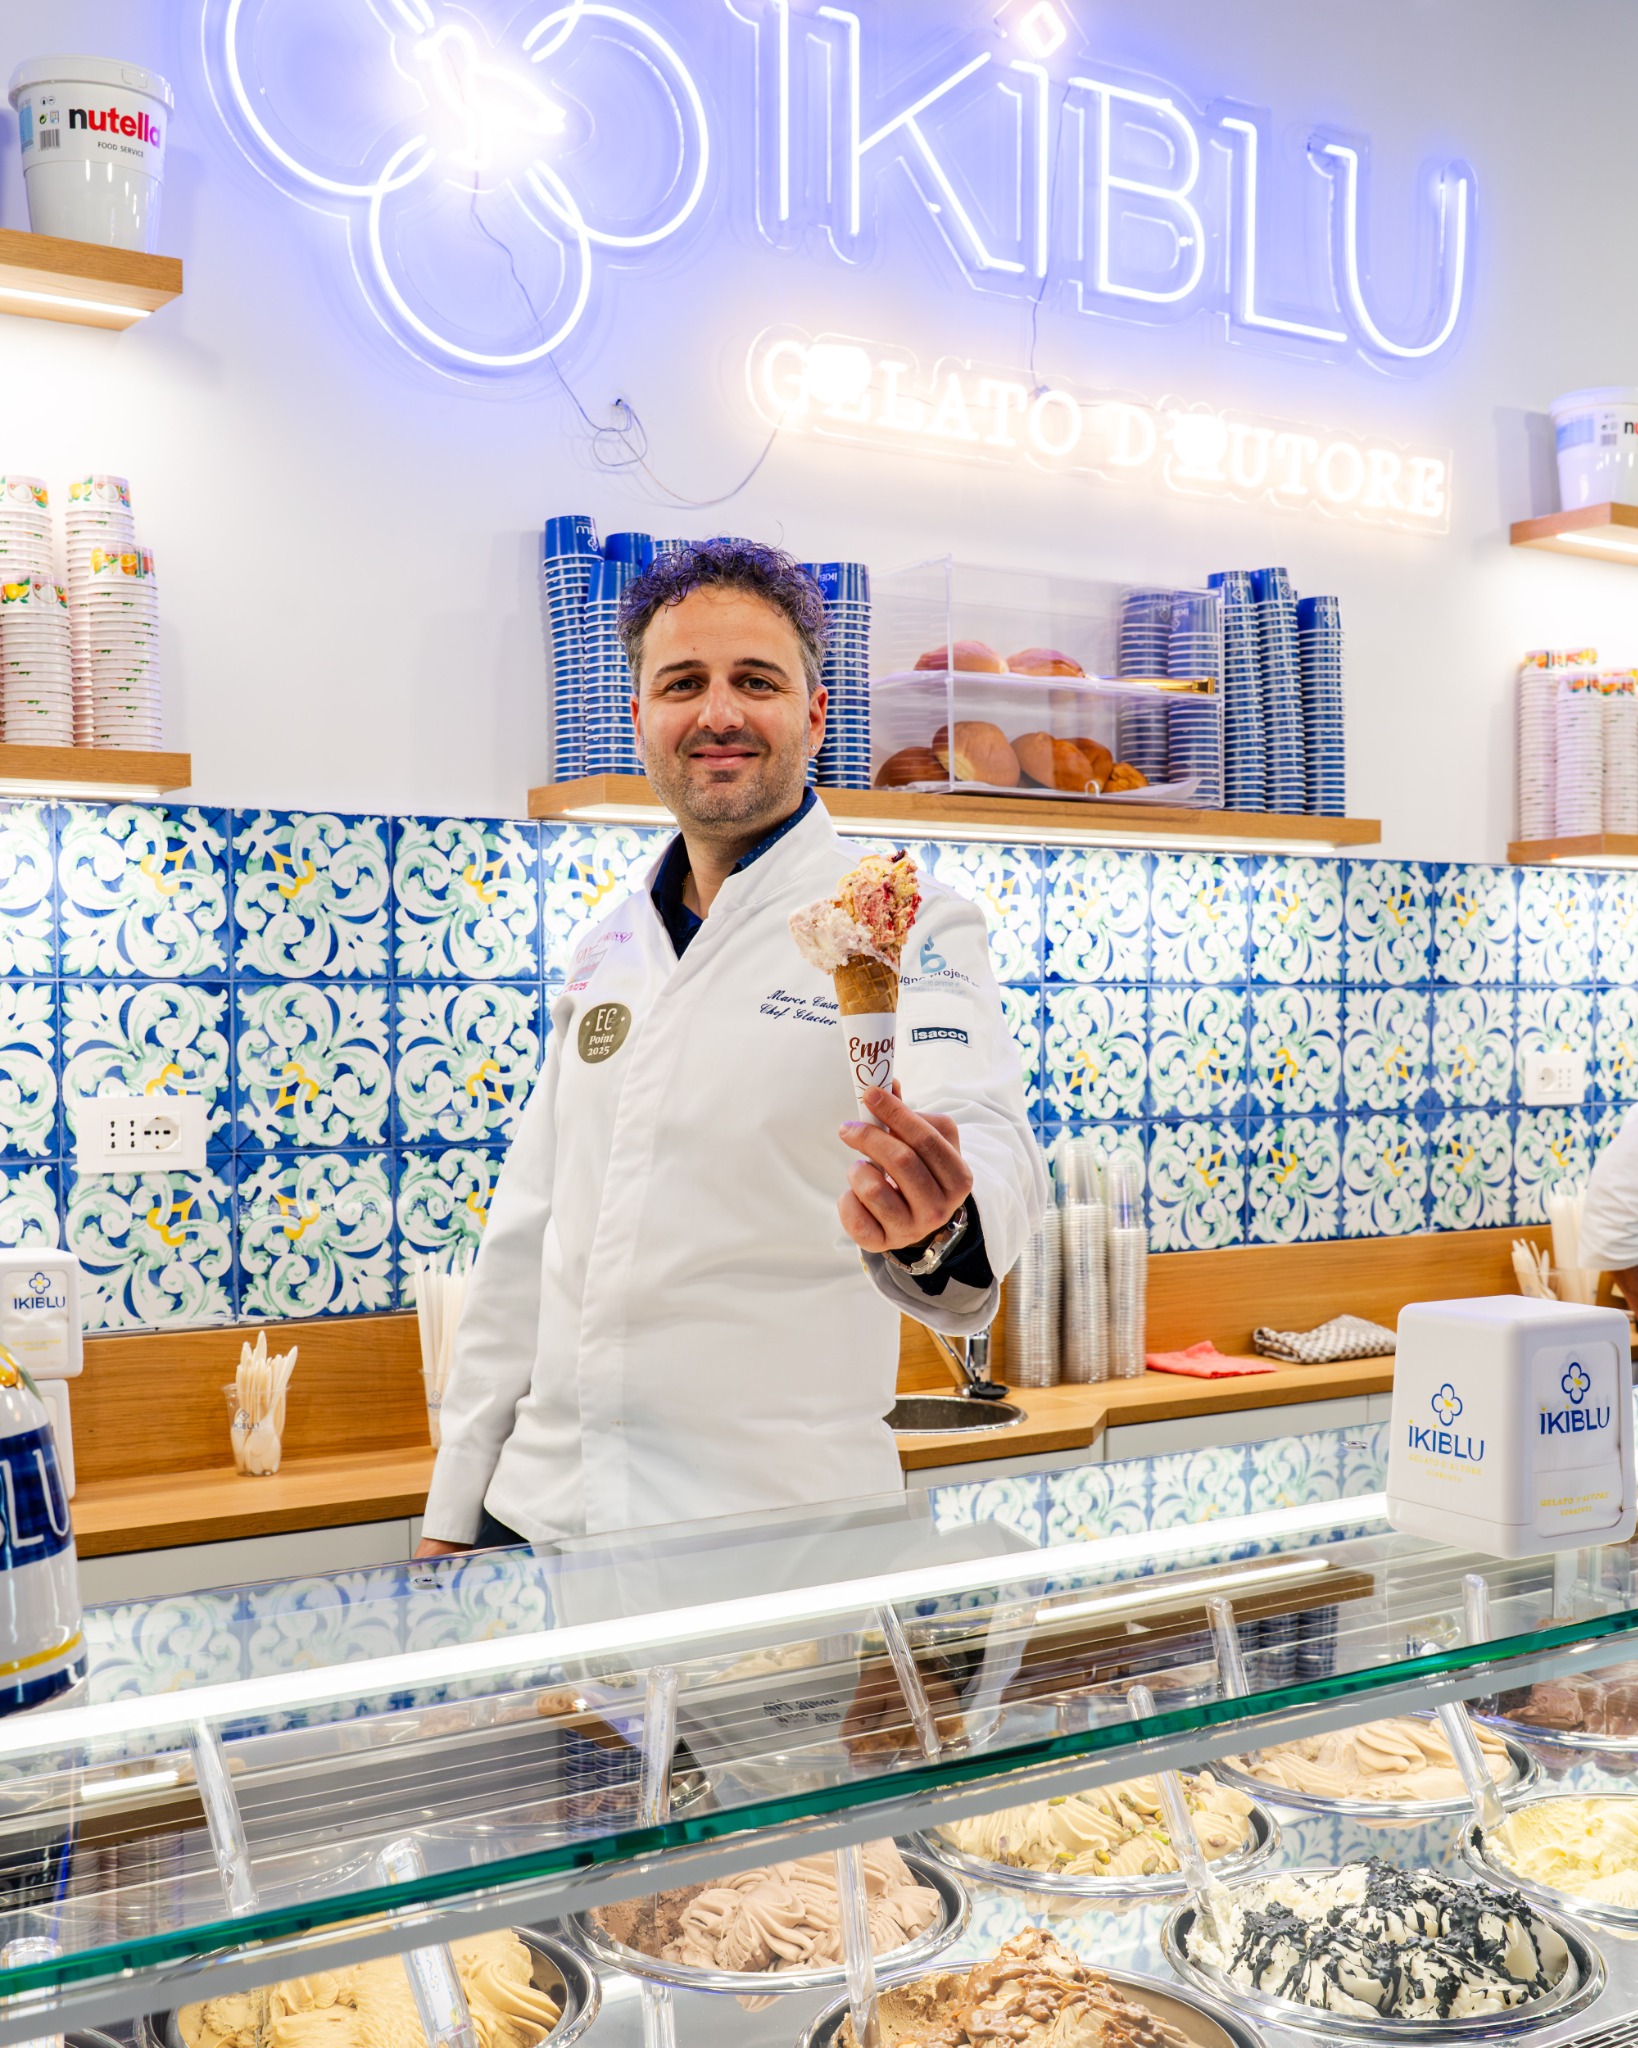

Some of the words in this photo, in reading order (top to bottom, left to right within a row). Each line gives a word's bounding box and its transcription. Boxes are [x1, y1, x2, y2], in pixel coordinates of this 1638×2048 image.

[69, 107, 161, 149] nutella
[97, 141, 118, 151] FOOD
[120, 145, 144, 158] SERVICE
[767, 989, 807, 1005] Marco
[759, 1003, 791, 1019] Chef
[594, 1007, 618, 1032] EC
[588, 1033, 616, 1045] Point
[913, 1029, 967, 1041] isacco
[586, 1045, 611, 1057] 2025
[13, 1295, 66, 1310] IKIBLU
[1538, 1405, 1610, 1435] IKIBLU
[1408, 1419, 1485, 1462] IKIBLU
[1540, 1497, 1574, 1507] GELATO
